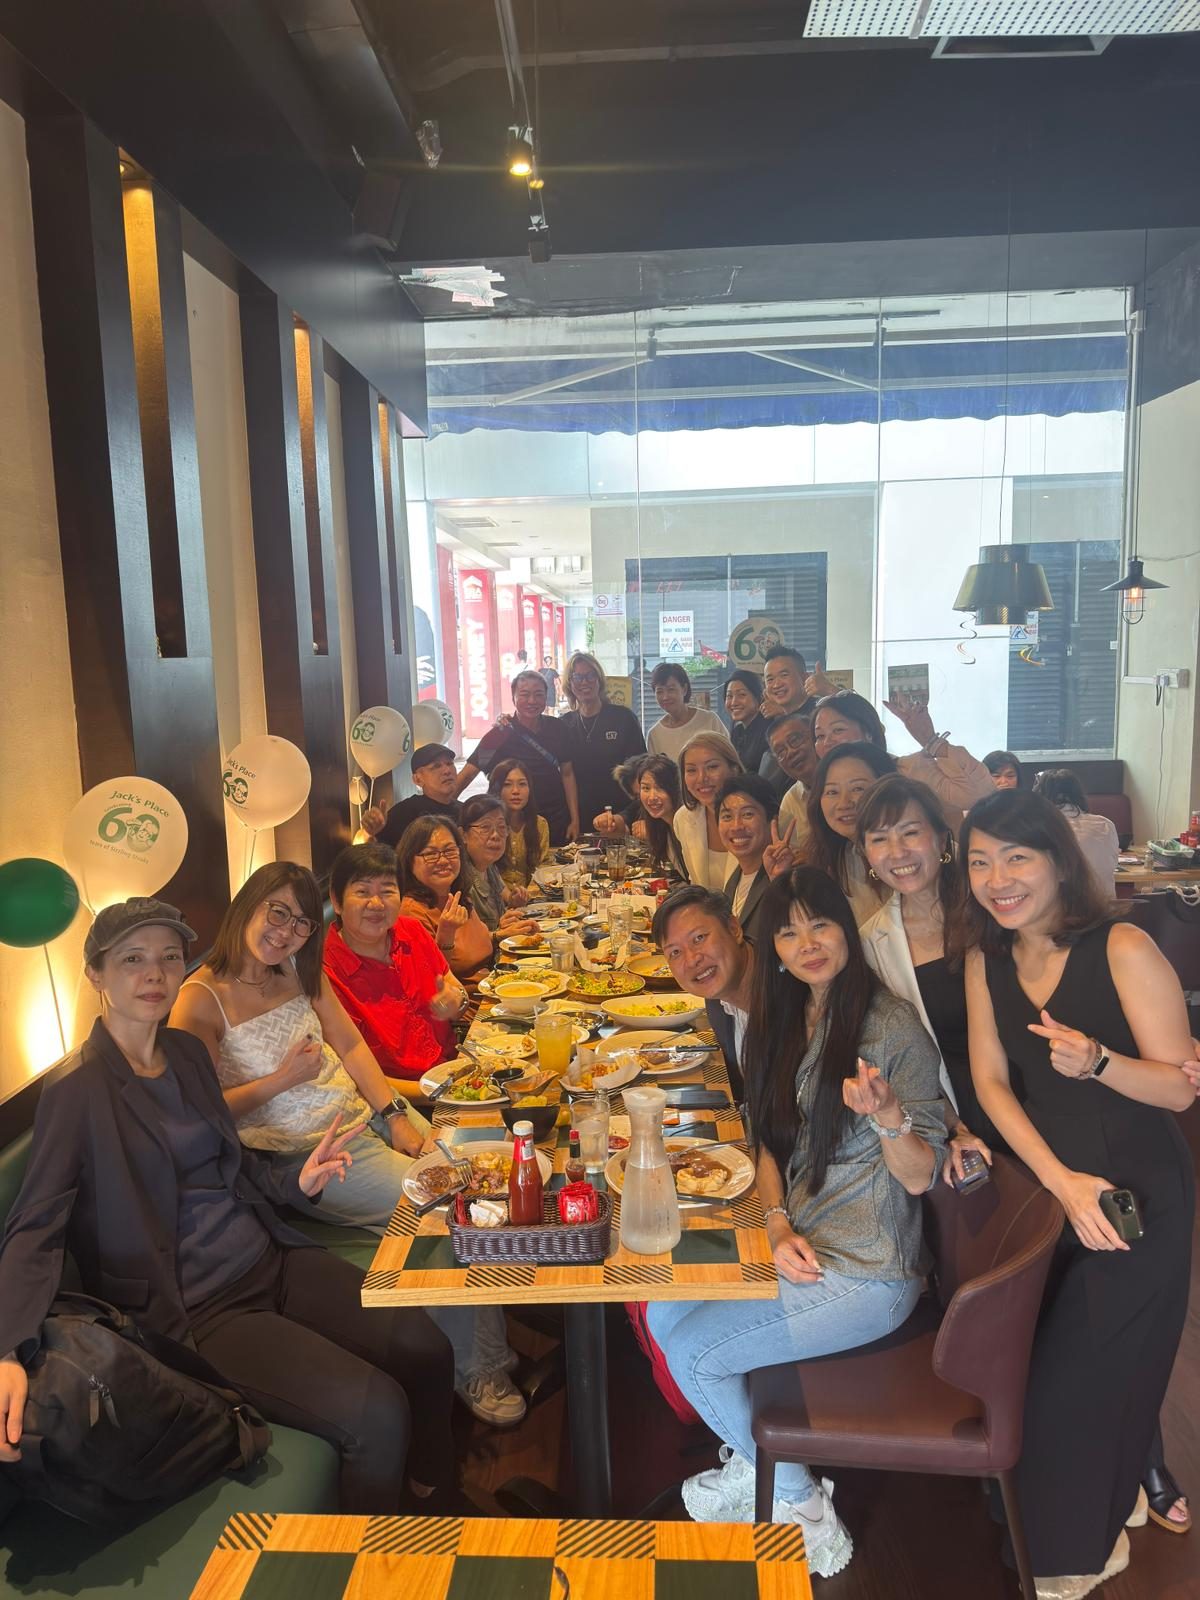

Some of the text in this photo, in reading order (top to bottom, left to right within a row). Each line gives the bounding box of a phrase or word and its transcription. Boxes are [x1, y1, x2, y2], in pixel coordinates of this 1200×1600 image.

[662, 615, 691, 624] DANGER
[467, 617, 489, 721] JOURNEY
[351, 720, 376, 743] 60
[110, 790, 169, 817] Jack's Place
[98, 806, 160, 853] 60
